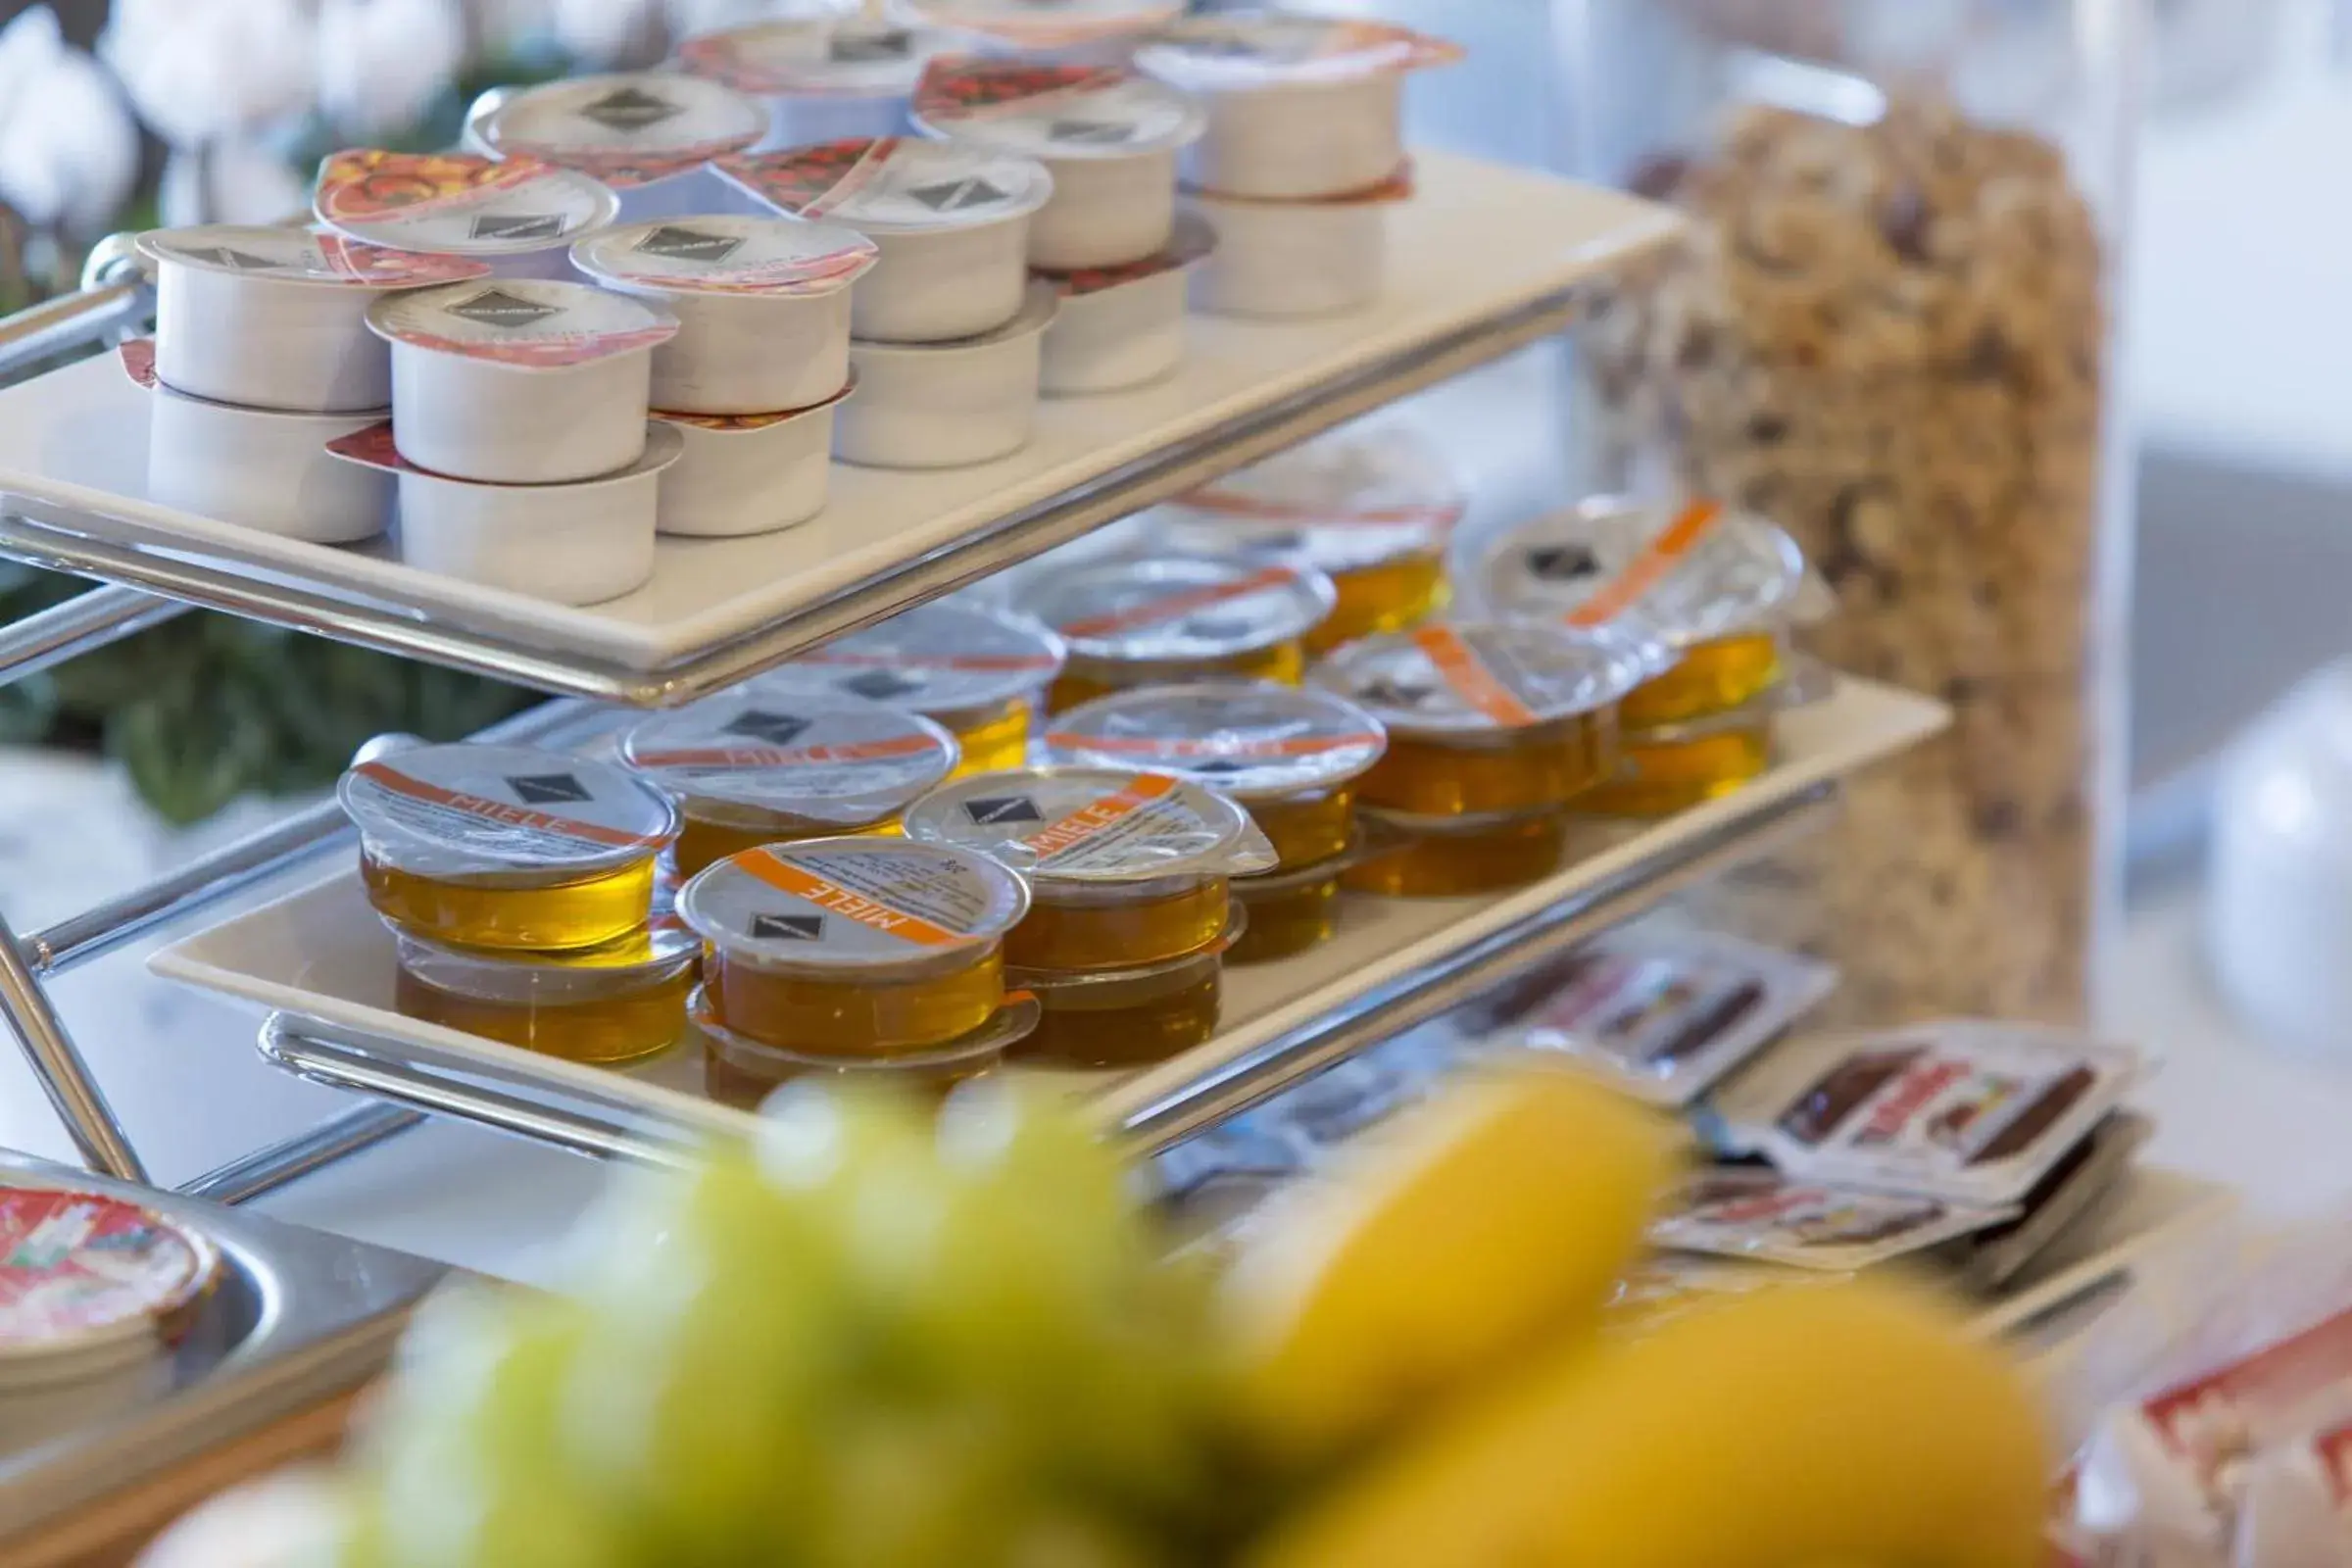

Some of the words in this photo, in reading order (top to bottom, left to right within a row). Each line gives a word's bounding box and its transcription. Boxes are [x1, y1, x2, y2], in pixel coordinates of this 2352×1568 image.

[448, 794, 568, 829] MIELE
[1025, 805, 1123, 852] MIELE
[799, 881, 909, 930] MIELE
